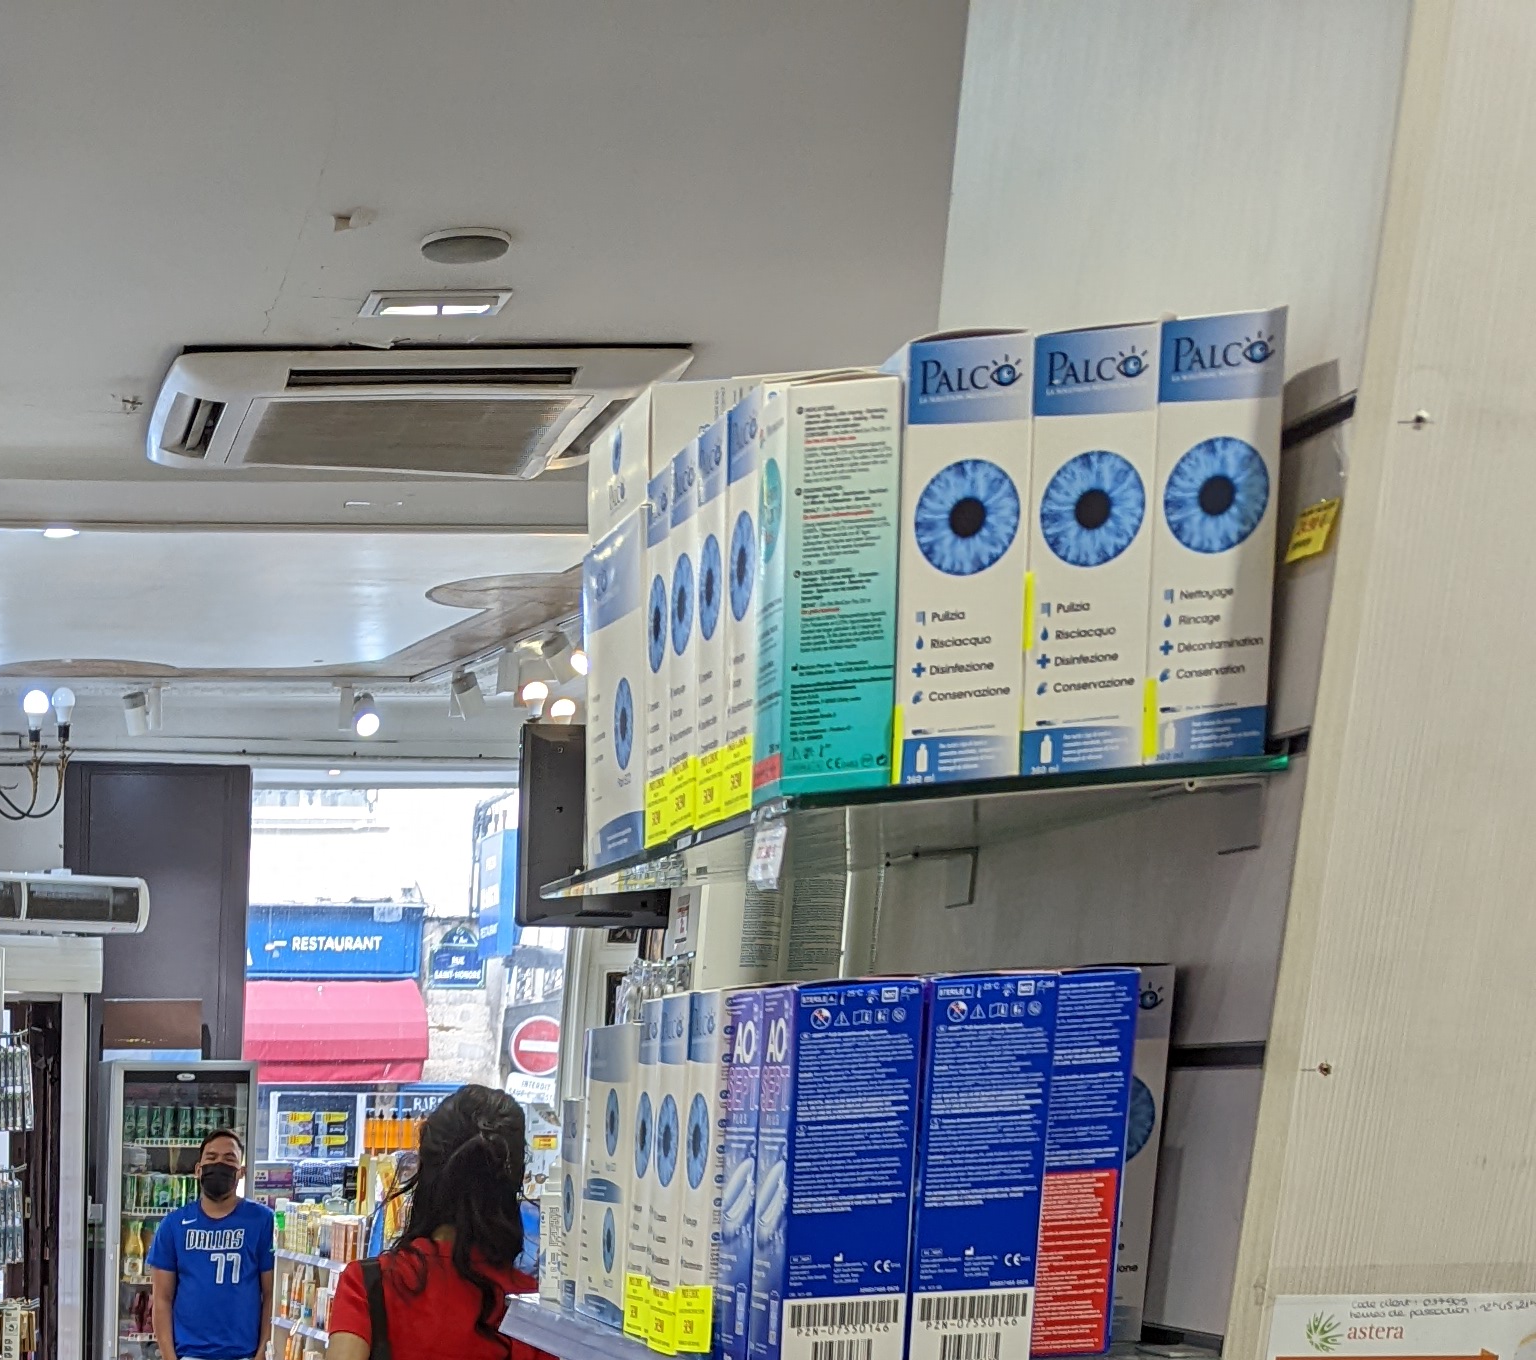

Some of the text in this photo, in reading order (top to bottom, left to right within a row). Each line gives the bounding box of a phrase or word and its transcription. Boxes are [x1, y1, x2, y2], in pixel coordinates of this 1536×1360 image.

[1047, 348, 1148, 386] PALCO
[1173, 333, 1275, 372] PALCO
[921, 356, 1023, 394] PALCO
[292, 935, 383, 951] RESTAURANT
[186, 1228, 246, 1250] DALLAS
[210, 1252, 242, 1285] 77
[1347, 1323, 1405, 1340] astera
